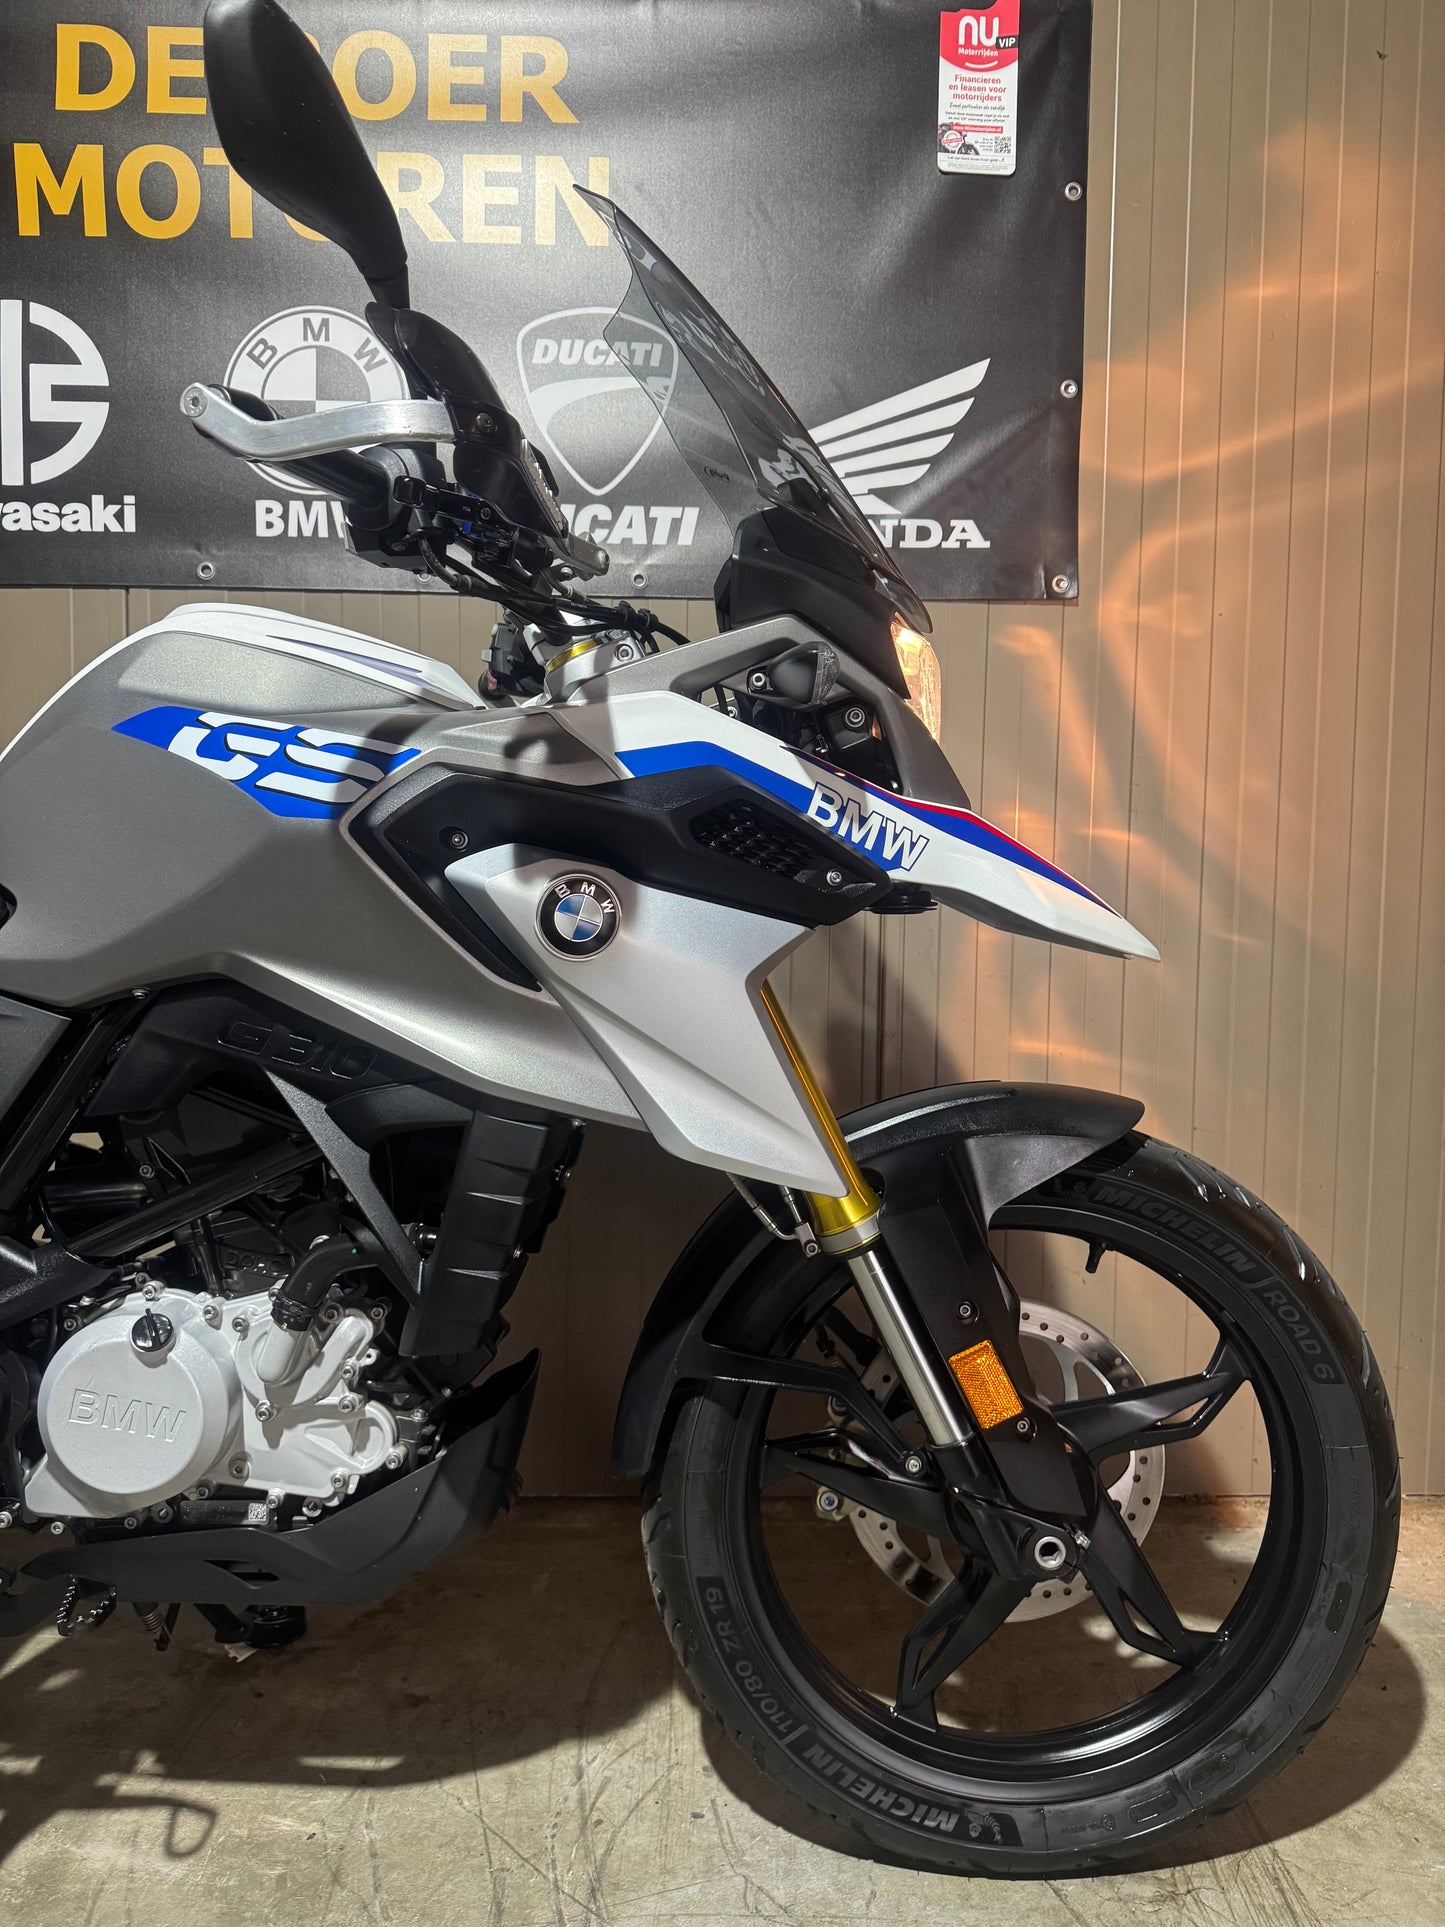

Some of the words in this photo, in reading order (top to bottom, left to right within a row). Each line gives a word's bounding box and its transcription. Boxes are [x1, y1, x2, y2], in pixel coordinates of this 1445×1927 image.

[958, 47, 999, 58] Motorrijden
[998, 37, 1016, 48] VIP
[54, 23, 207, 115] DE
[303, 30, 579, 124] OER
[954, 74, 1001, 84] Financieren
[960, 83, 987, 92] leasen
[952, 92, 1002, 103] motorrijders
[13, 142, 610, 247] MOTREN
[247, 316, 389, 374] BMW
[531, 337, 663, 367] DUCATI
[0, 494, 136, 533] asaki
[560, 503, 700, 546] CATI
[867, 518, 990, 549] NDA
[167, 711, 411, 805] GS
[805, 781, 931, 873] BMW
[555, 881, 615, 915] BMW
[1097, 1185, 1257, 1273] MICHELIN
[1263, 1290, 1321, 1356] ROAD
[1312, 1362, 1336, 1381] 6
[68, 1388, 187, 1444] BMW
[705, 1586, 728, 1612] 19
[716, 1617, 743, 1654] ZR
[736, 1659, 792, 1736] 110/80
[802, 1742, 960, 1834] MICHELIN
